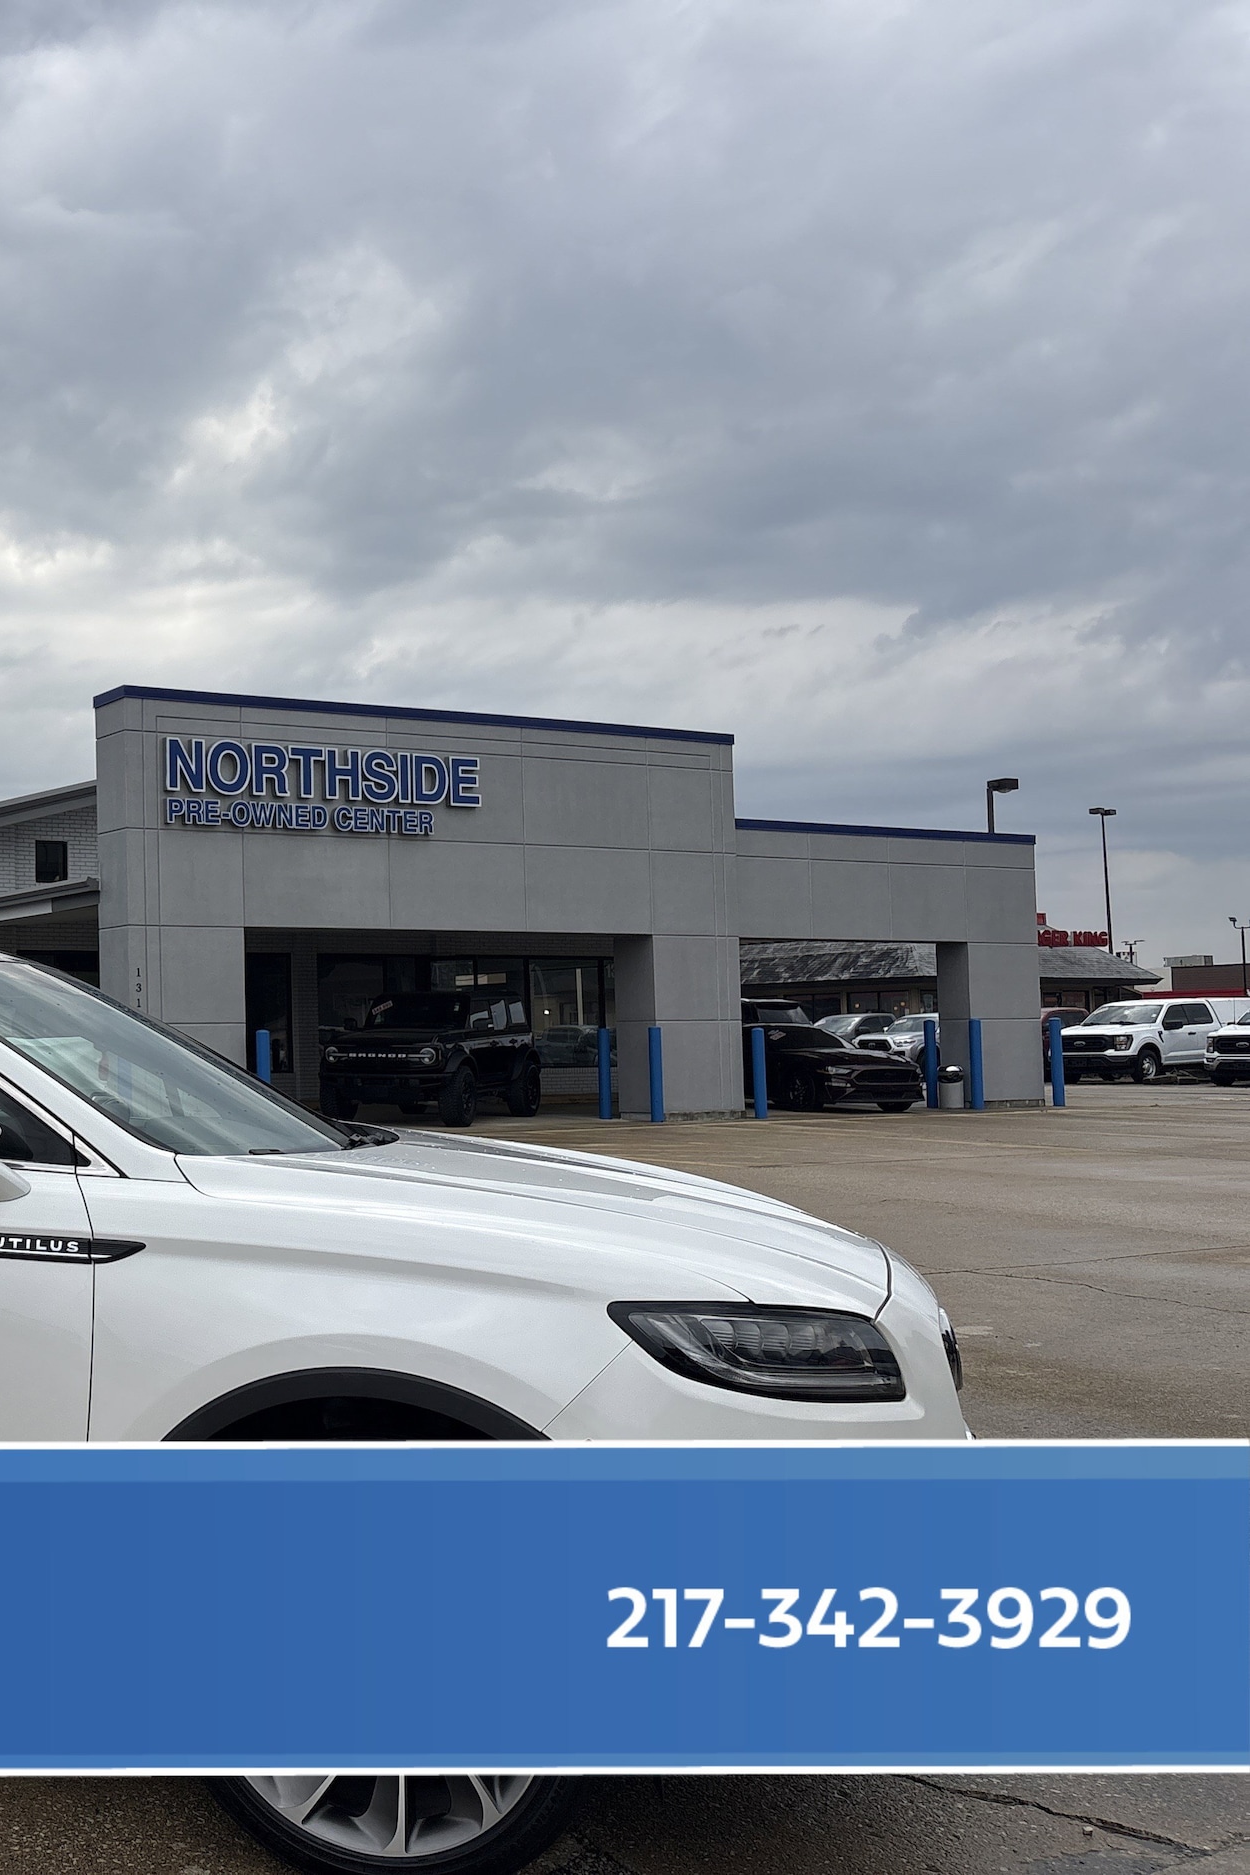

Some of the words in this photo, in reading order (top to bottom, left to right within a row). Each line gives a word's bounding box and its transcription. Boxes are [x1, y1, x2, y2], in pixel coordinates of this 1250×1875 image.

[166, 737, 482, 807] NORTHSIDE
[166, 797, 328, 830] PRE-OWNED
[333, 806, 434, 834] CENTER
[1038, 929, 1070, 947] GER
[1072, 930, 1109, 948] KING
